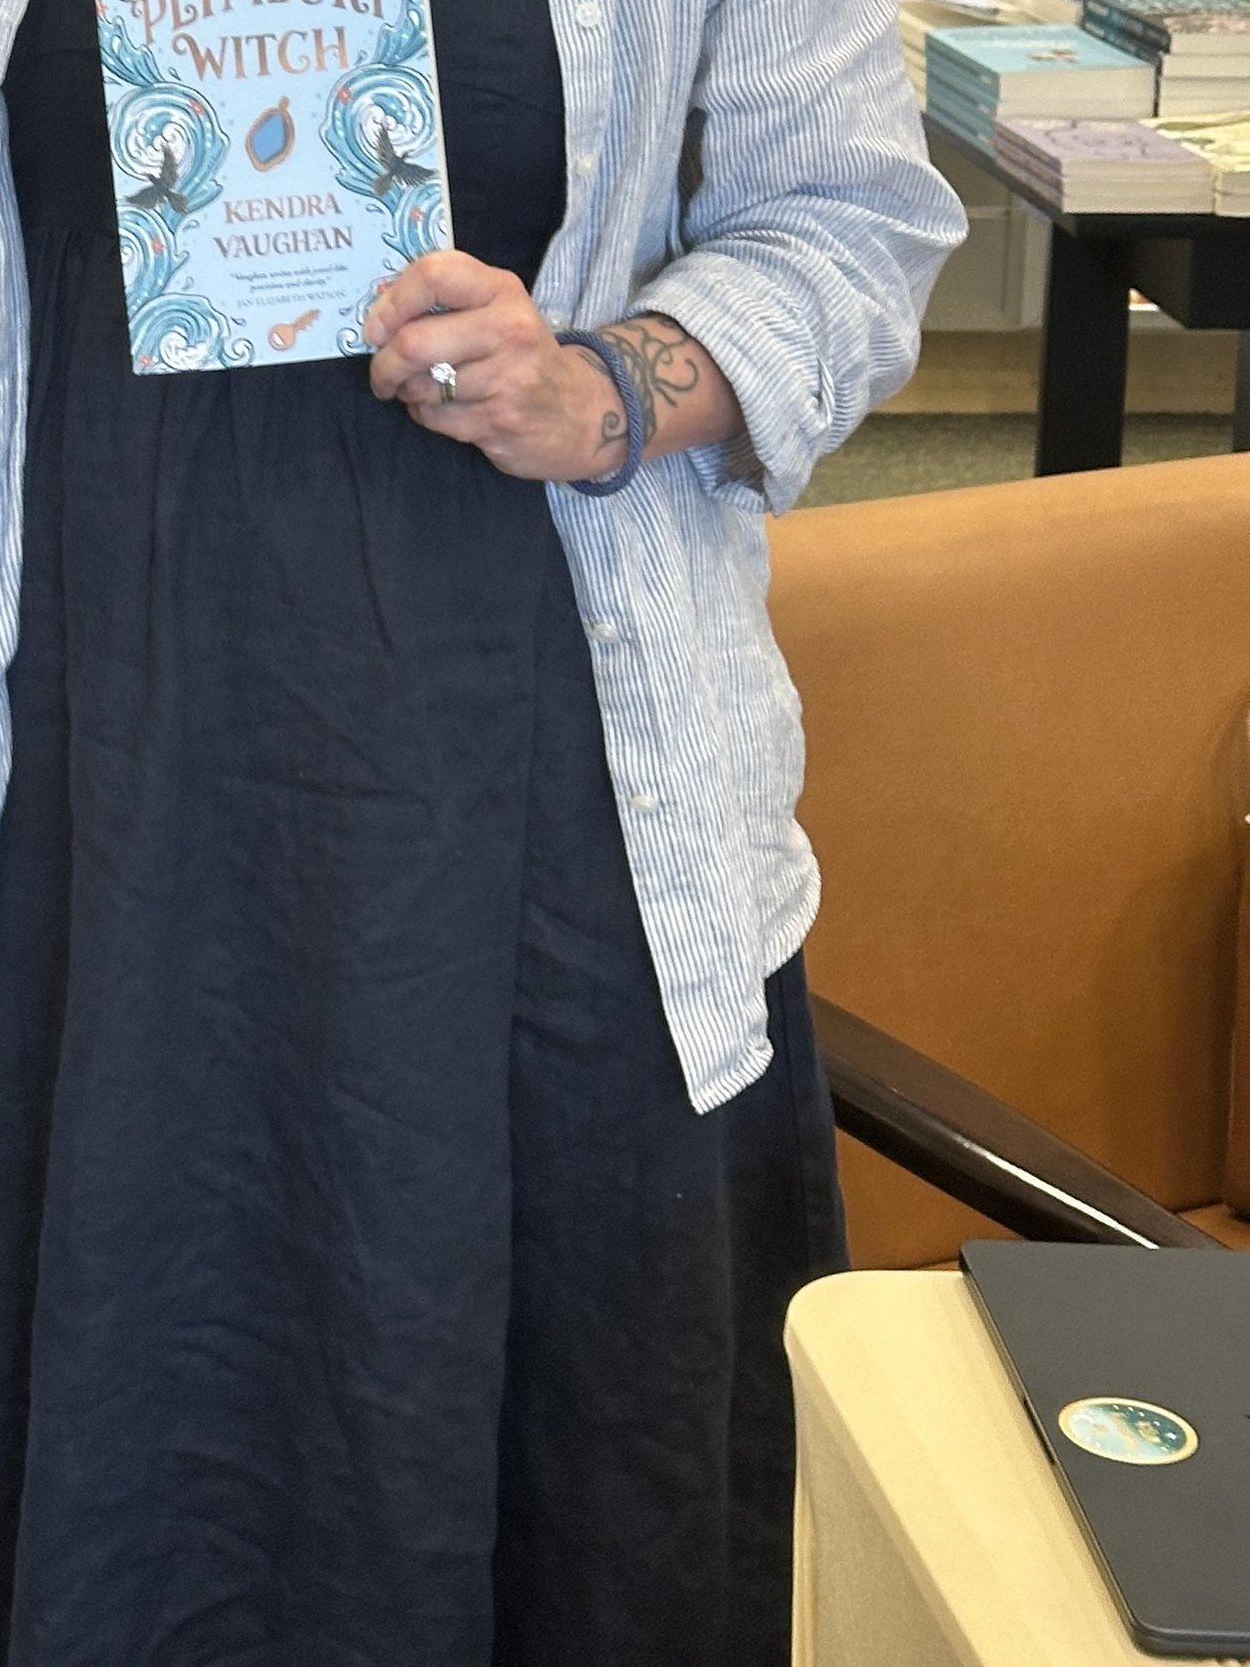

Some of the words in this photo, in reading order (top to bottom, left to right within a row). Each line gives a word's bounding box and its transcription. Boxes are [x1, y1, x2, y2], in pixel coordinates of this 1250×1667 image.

[172, 26, 351, 83] WITCH
[222, 192, 342, 224] KENDRA
[212, 224, 354, 259] VAUGHAN
